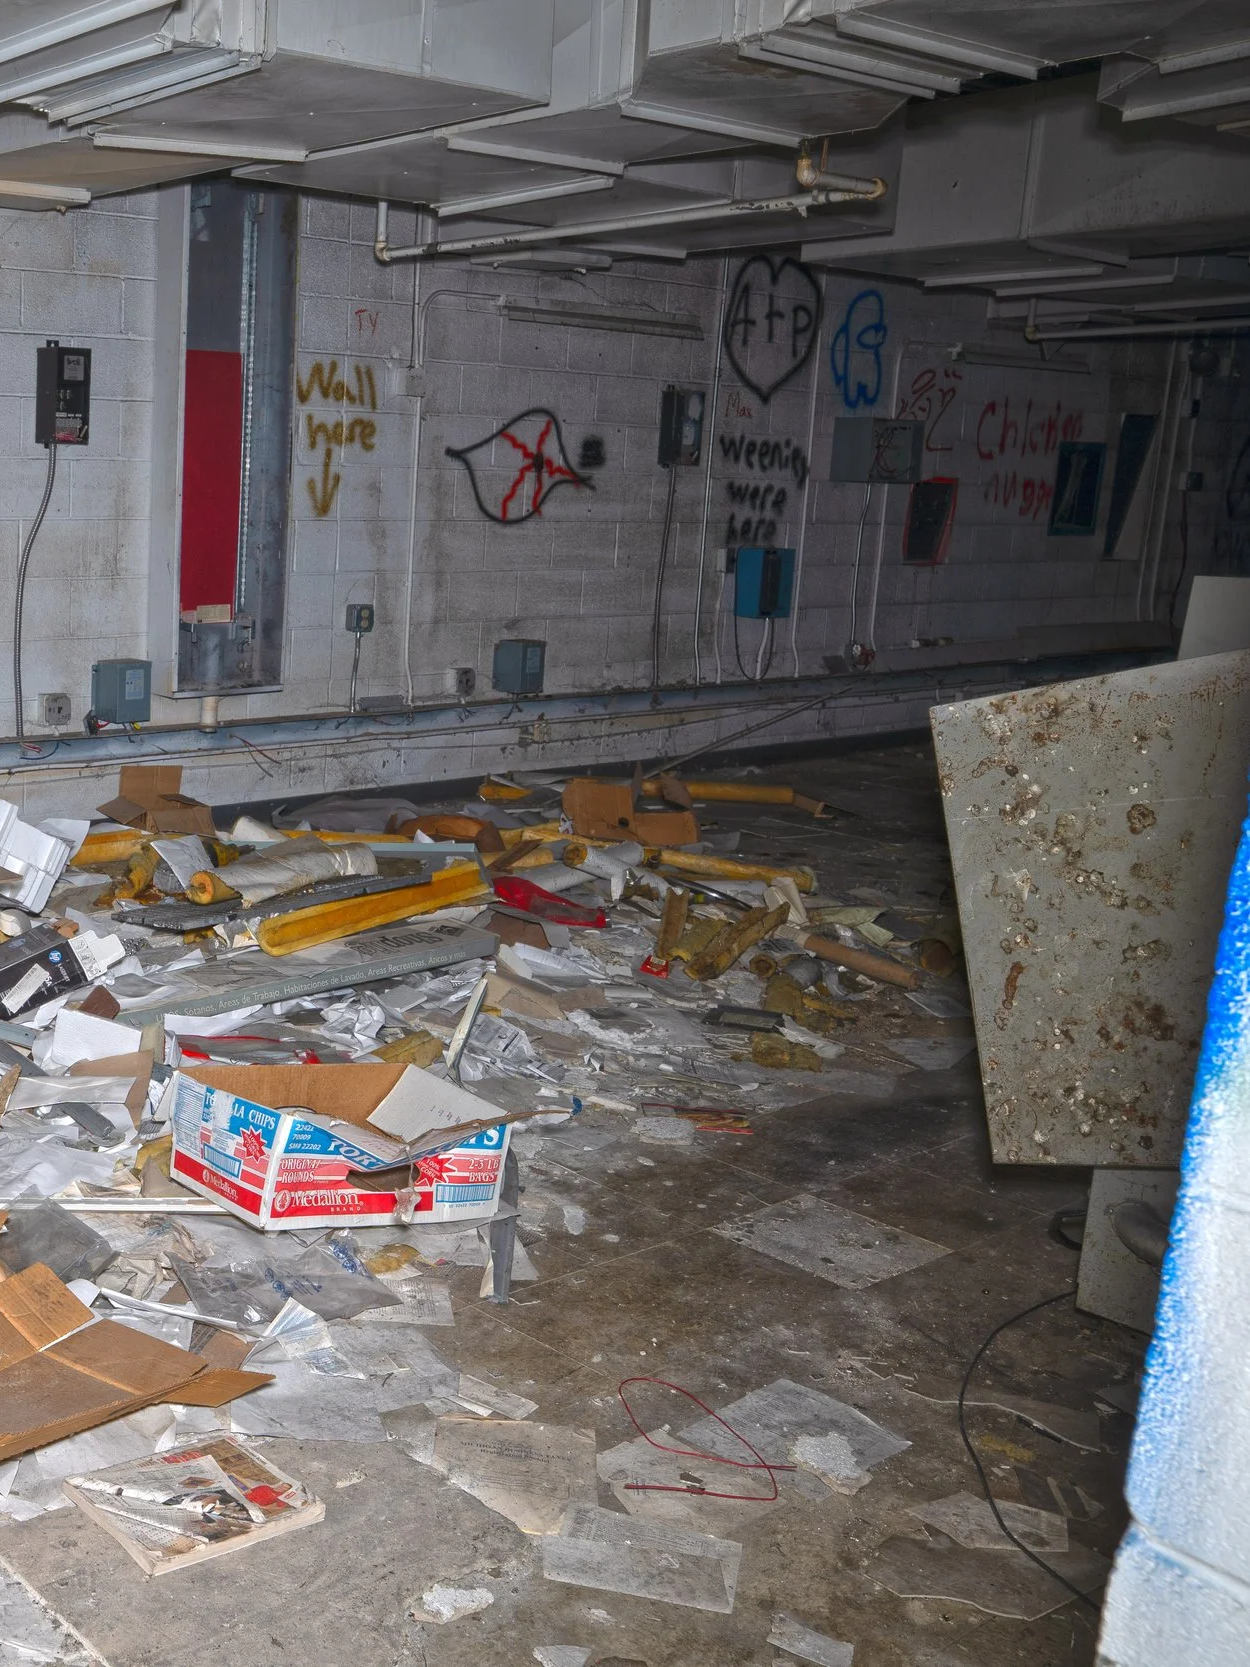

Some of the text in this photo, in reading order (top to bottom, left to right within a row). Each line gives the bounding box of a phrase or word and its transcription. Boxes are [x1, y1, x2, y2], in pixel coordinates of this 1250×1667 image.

[296, 359, 377, 410] Wall
[306, 413, 376, 452] here
[726, 480, 787, 515] were
[726, 511, 777, 546] here
[241, 995, 250, 1004] de
[284, 978, 329, 996] Habitaciones
[330, 974, 339, 984] de
[249, 1109, 276, 1130] CHIPS
[301, 1142, 321, 1150] 22202
[487, 1159, 499, 1169] LB
[281, 1171, 315, 1184] ROUNDS
[469, 1172, 495, 1183] BAGS
[292, 1189, 359, 1207] Medallion
